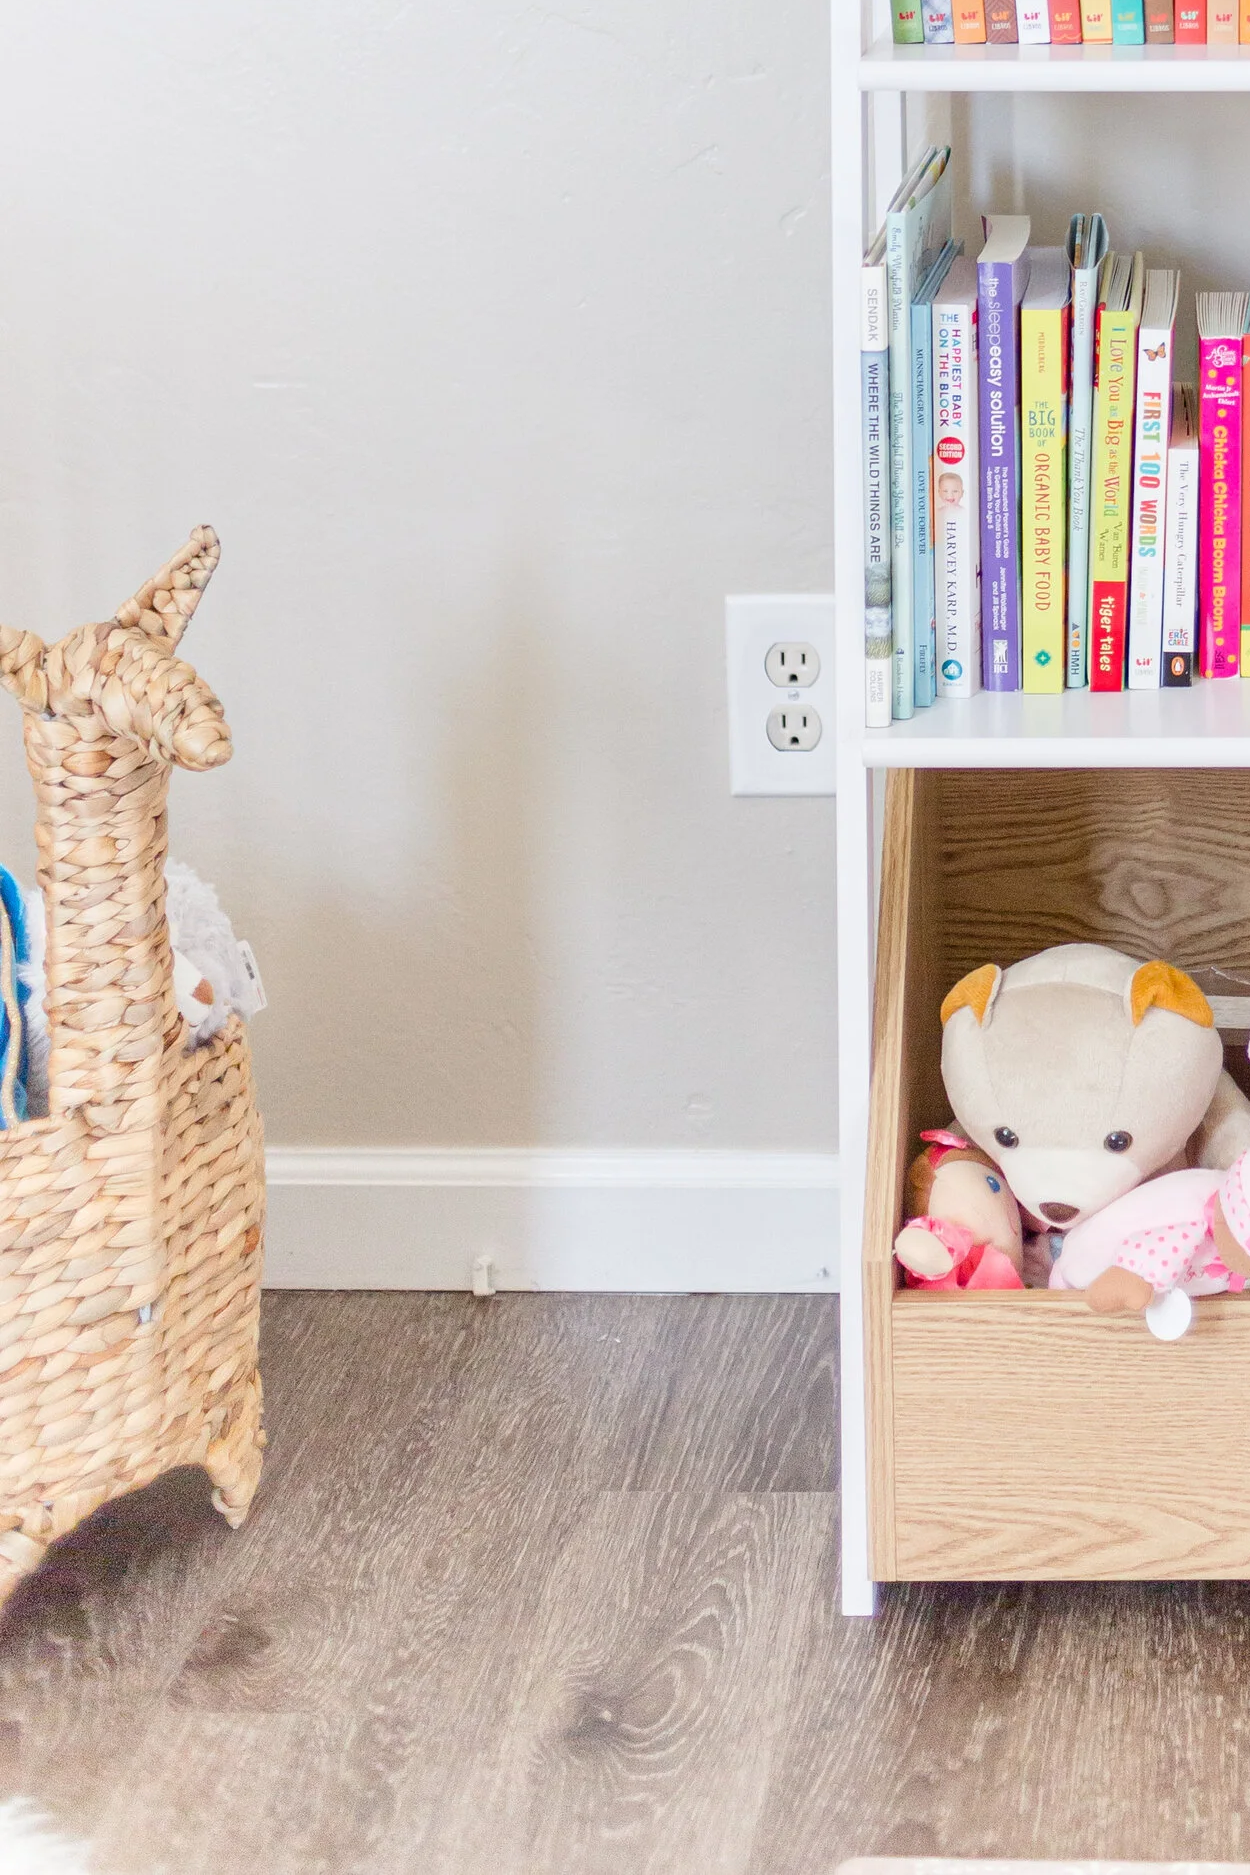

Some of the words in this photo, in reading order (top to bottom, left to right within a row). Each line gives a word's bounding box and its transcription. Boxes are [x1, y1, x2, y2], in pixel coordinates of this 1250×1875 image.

[988, 277, 1000, 297] the
[867, 288, 878, 342] SENDAK
[939, 313, 959, 323] THE
[939, 328, 949, 348] ON
[986, 301, 1004, 387] sleepeasy
[939, 354, 949, 378] THE
[951, 329, 962, 390] HAPPIEST
[1109, 339, 1127, 372] Love
[867, 363, 879, 412] WHERE
[1107, 376, 1124, 402] You
[939, 383, 950, 427] BLOCK
[951, 395, 962, 428] BABY
[1028, 410, 1056, 426] BIG
[1035, 401, 1049, 409] THE
[1109, 405, 1119, 418] as
[1142, 392, 1162, 443] FIRST
[868, 416, 880, 441] THE
[990, 390, 1007, 457] solution
[1029, 428, 1056, 438] BOOK
[1074, 428, 1086, 447] The
[1104, 420, 1125, 445] Big
[938, 443, 963, 451] SECOND
[939, 450, 963, 458] EDITION
[1037, 439, 1047, 447] OF
[1109, 449, 1118, 459] as
[1213, 425, 1229, 480] Chicka
[869, 445, 880, 479] WILD
[1073, 450, 1085, 481] Thank
[1108, 460, 1120, 475] the
[1139, 452, 1162, 489] 100
[1179, 461, 1189, 481] The
[917, 470, 925, 494] LOVE
[1034, 453, 1051, 521] ORGANIC
[1071, 480, 1085, 503] You
[1103, 476, 1120, 517] World
[1176, 483, 1188, 509] Very
[869, 481, 881, 531] THINGS
[918, 497, 926, 514] YOU
[1072, 504, 1084, 531] Book
[1213, 481, 1228, 535] Chicka
[918, 516, 926, 555] FOREVER
[1112, 521, 1122, 541] Van
[1138, 499, 1158, 558] WORDS
[1175, 512, 1188, 551] Hungry
[870, 535, 881, 563] ARE
[946, 521, 957, 576] HARVEY
[1034, 527, 1051, 566] BABY
[1112, 543, 1122, 569] Buren
[1213, 538, 1227, 583] Boom
[1034, 572, 1051, 611] FOOD
[1173, 553, 1187, 607] Caterpillar
[946, 581, 957, 620] KARP,
[1098, 596, 1115, 633] tiger
[1212, 586, 1227, 632] Boom
[947, 625, 957, 655] M.D.
[1168, 628, 1189, 639] ERIC
[1071, 650, 1080, 676] HMH
[1099, 635, 1114, 672] tales
[869, 670, 877, 703] COLLINS
[876, 670, 884, 702] HARPER
